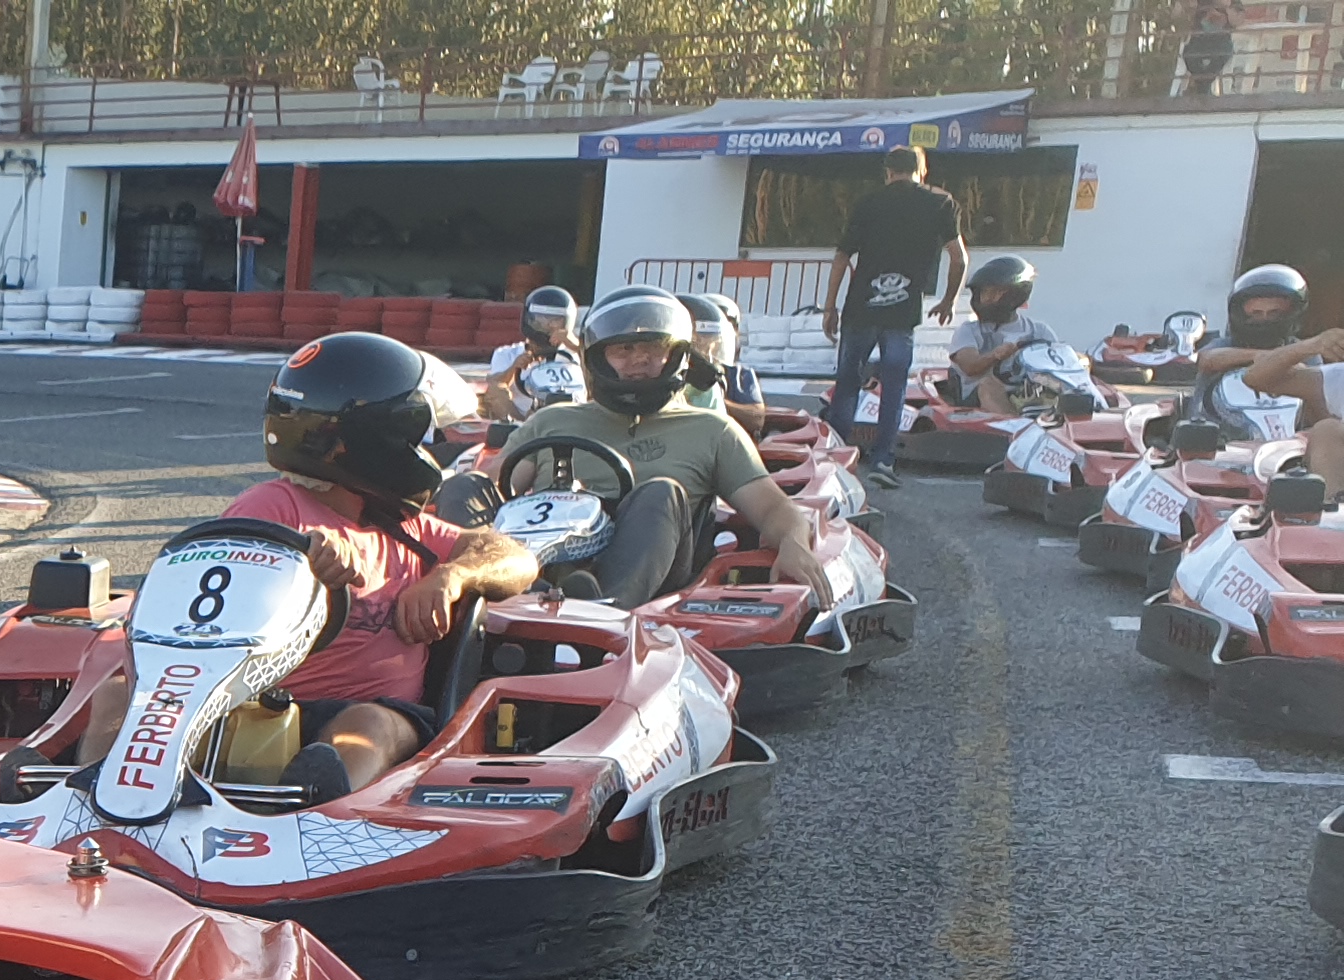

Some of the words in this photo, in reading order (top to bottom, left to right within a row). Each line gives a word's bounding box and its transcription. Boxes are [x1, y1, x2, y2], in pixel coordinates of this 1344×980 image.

[726, 130, 842, 148] SEGURANÇA
[967, 132, 1023, 151] SEGURANÇA
[1181, 318, 1194, 330] 10
[1047, 348, 1065, 366] 6
[545, 367, 573, 384] 30
[525, 502, 554, 525] 3
[167, 549, 283, 566] EUROINDY
[188, 565, 232, 624] 8
[116, 664, 201, 790] FERBERTO
[422, 792, 565, 806] PALOCAR
